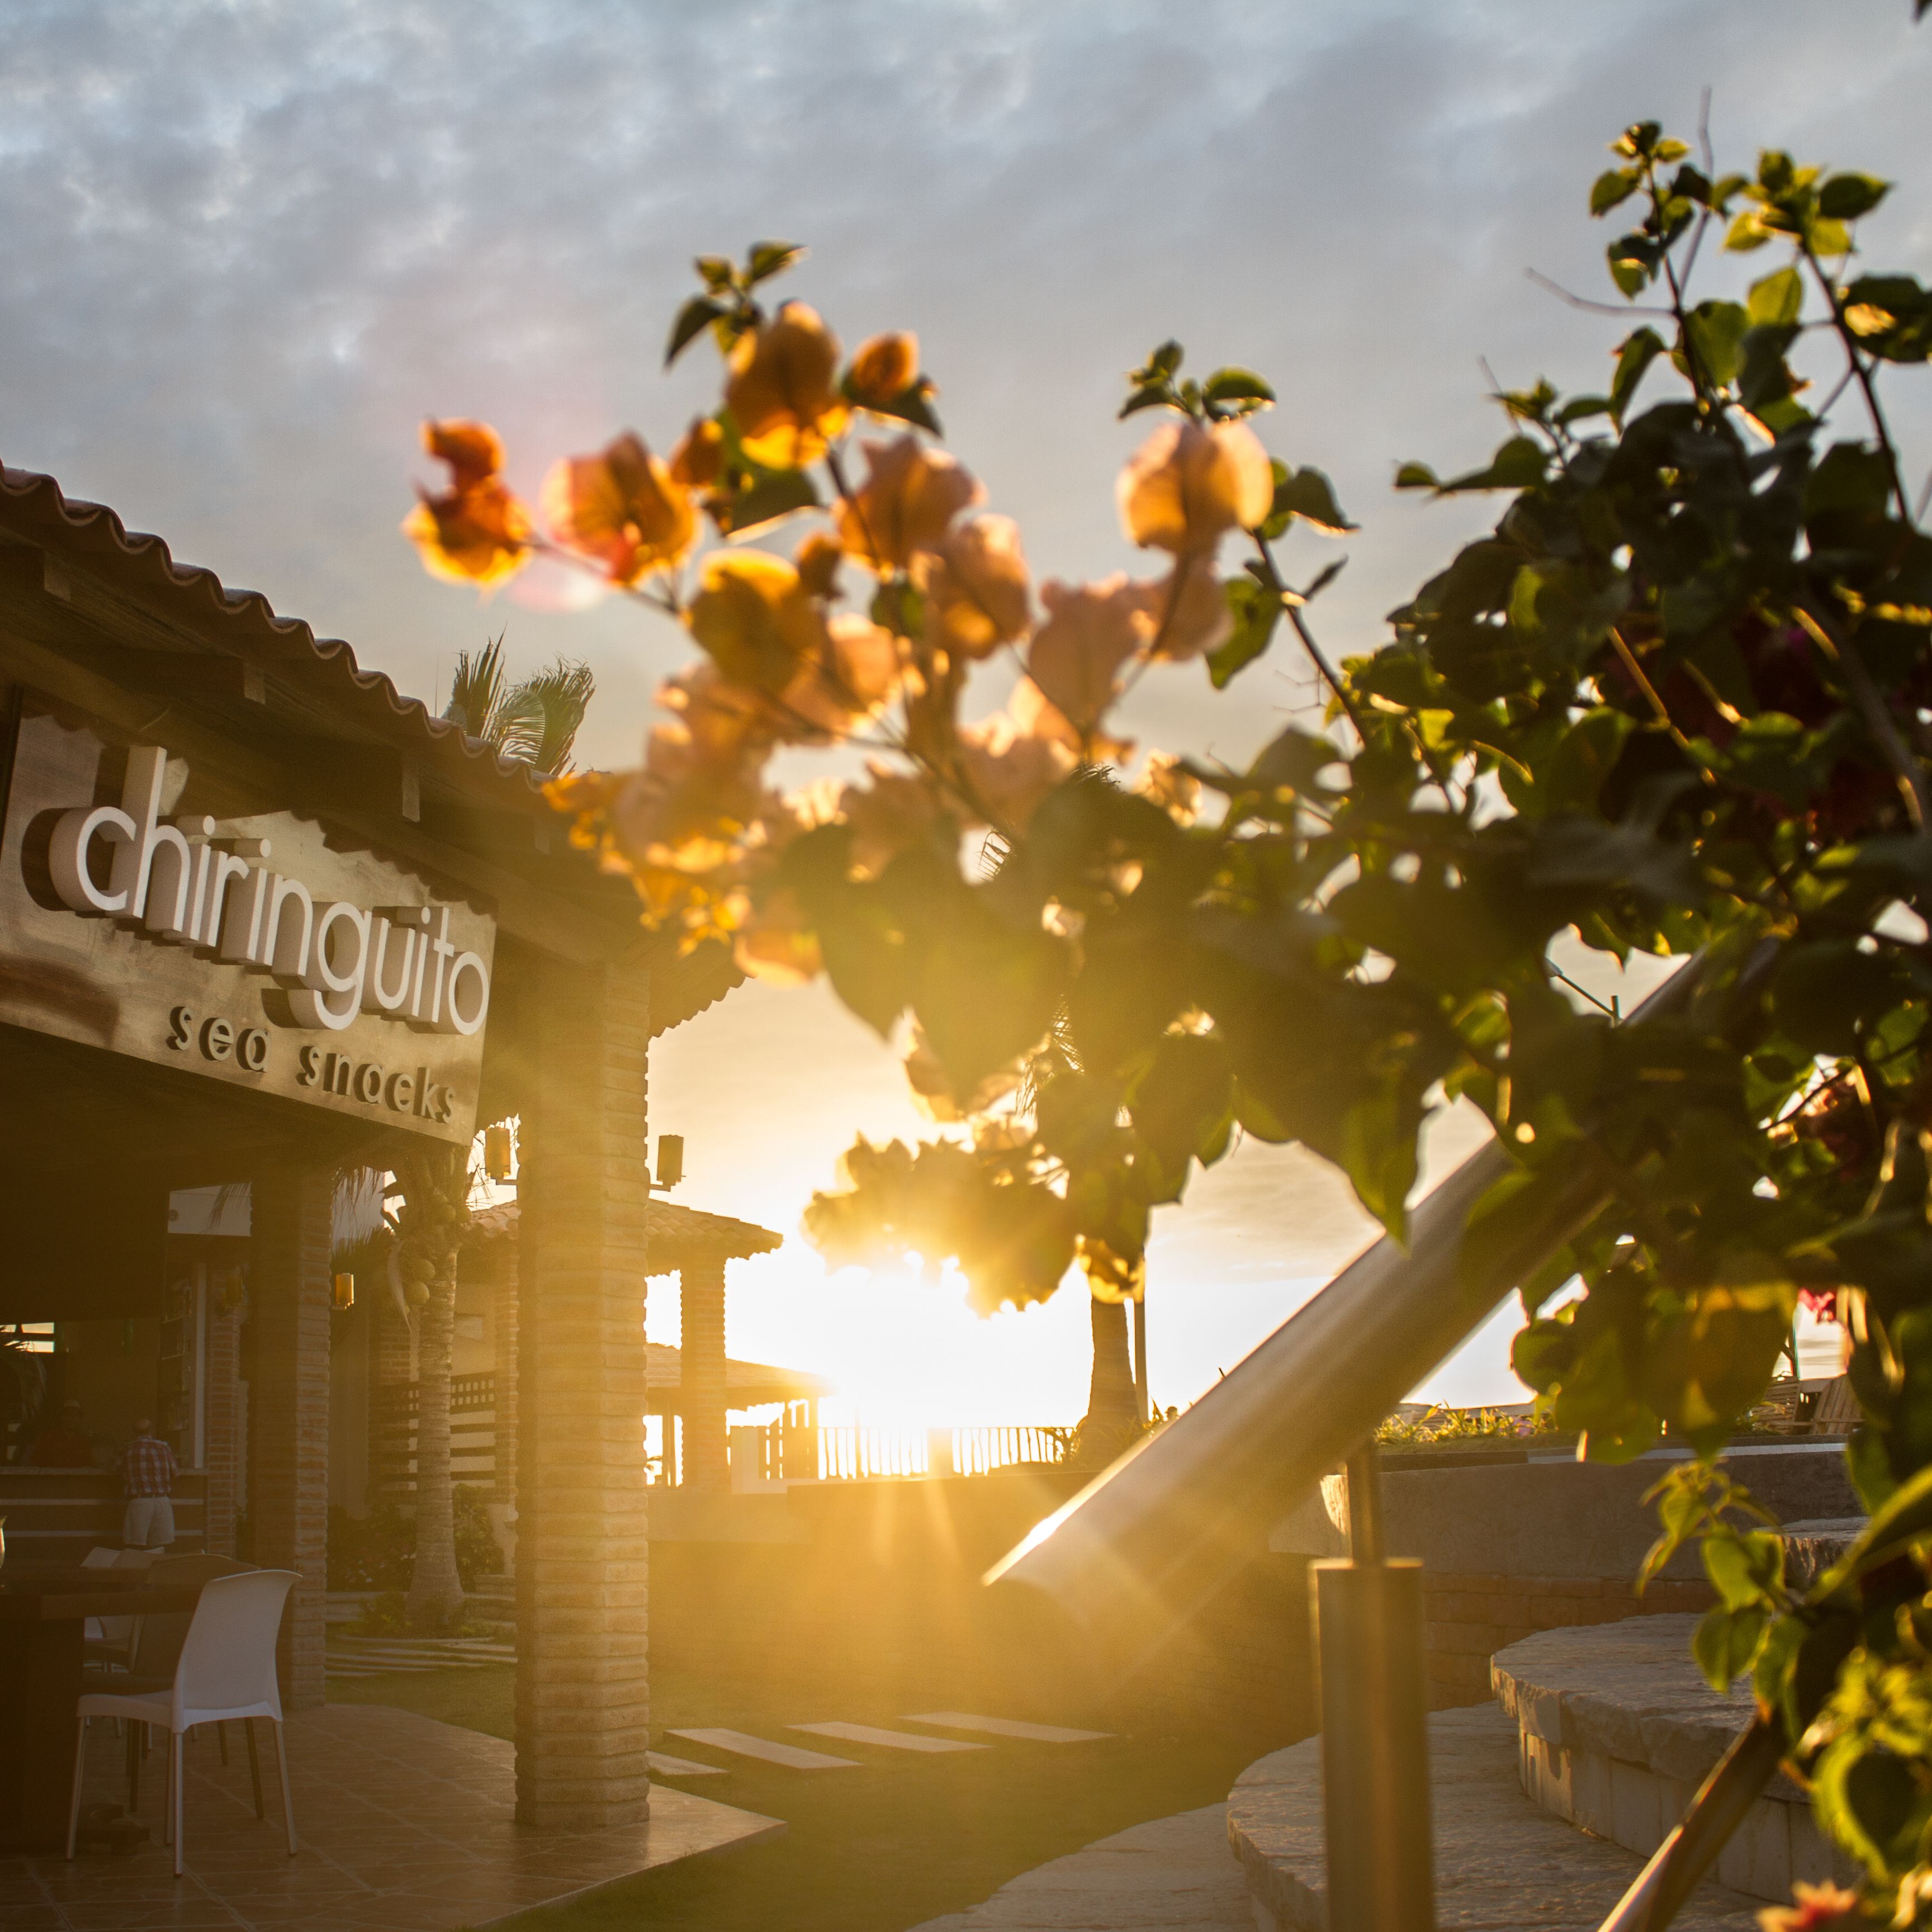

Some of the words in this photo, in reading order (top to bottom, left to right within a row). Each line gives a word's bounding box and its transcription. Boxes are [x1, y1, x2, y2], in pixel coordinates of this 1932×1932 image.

[70, 746, 490, 1035] chiringuito
[170, 1006, 271, 1072] sea
[301, 1045, 456, 1124] snacks
